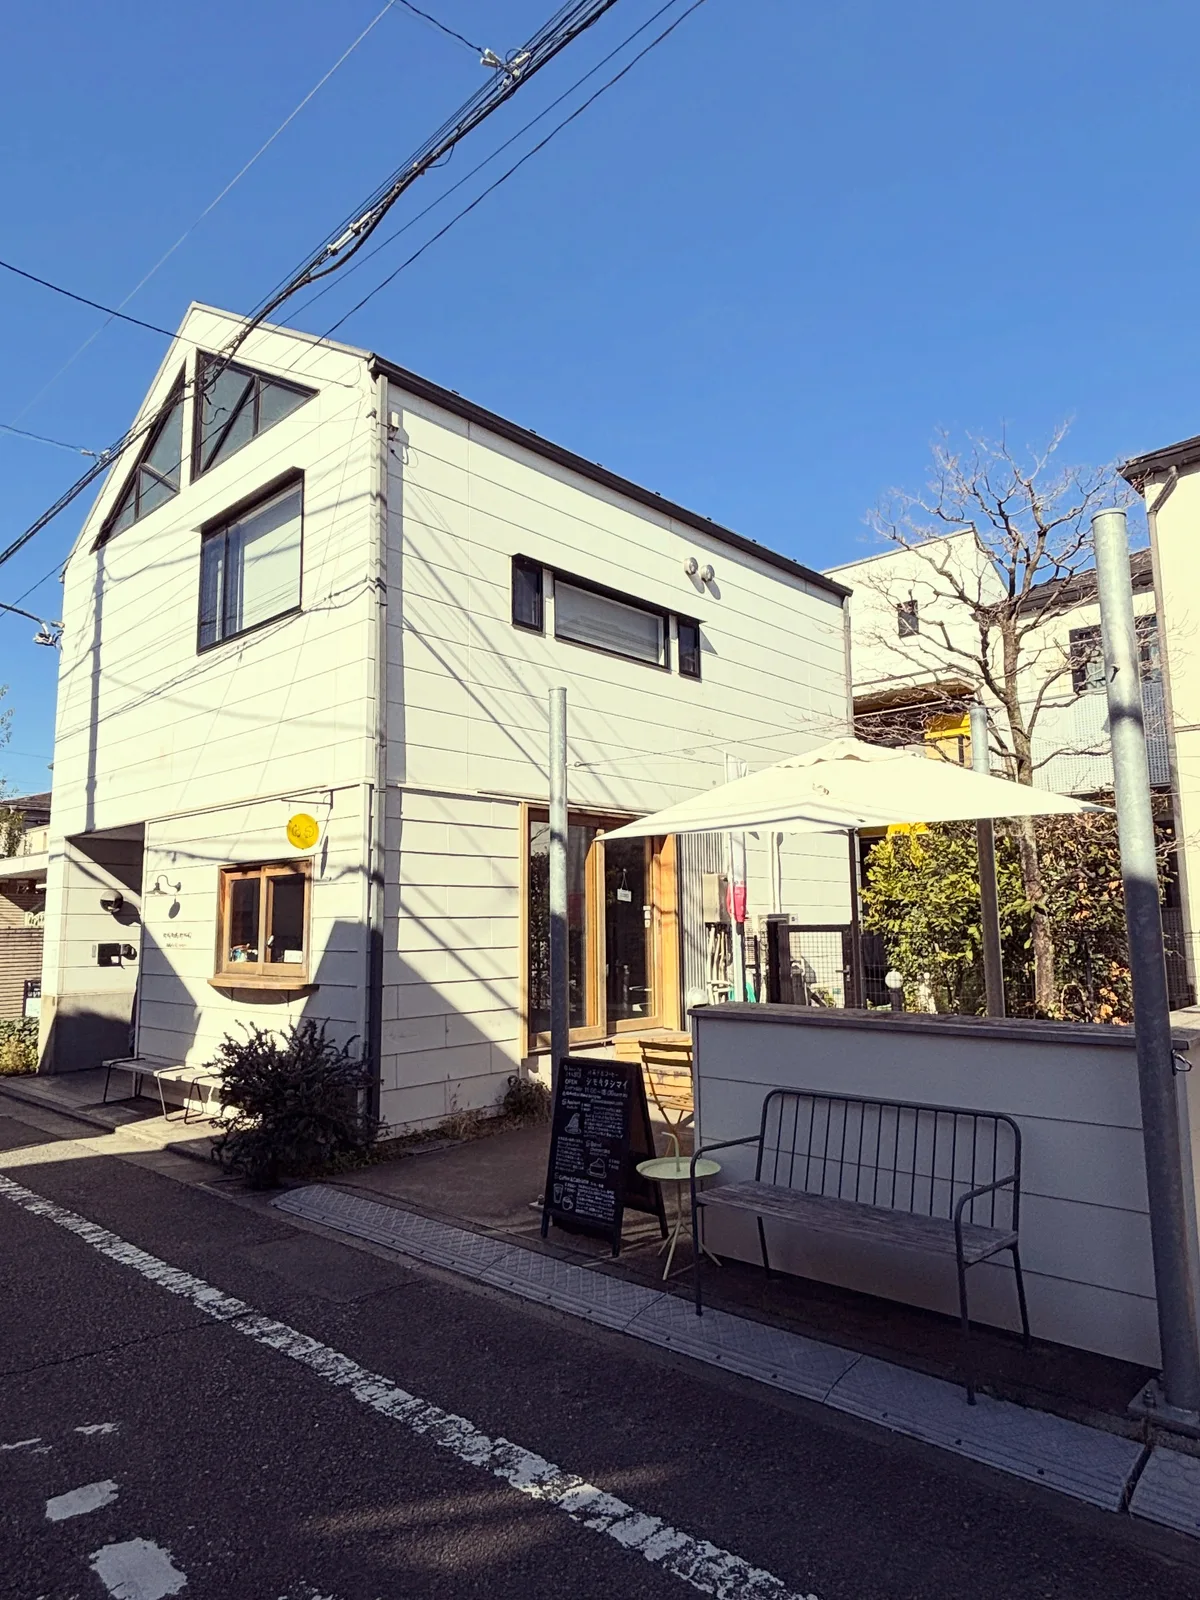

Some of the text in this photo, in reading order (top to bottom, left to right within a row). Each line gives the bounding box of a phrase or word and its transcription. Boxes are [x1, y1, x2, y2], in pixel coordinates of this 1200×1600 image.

[586, 1077, 629, 1090] シモキタシマイ
